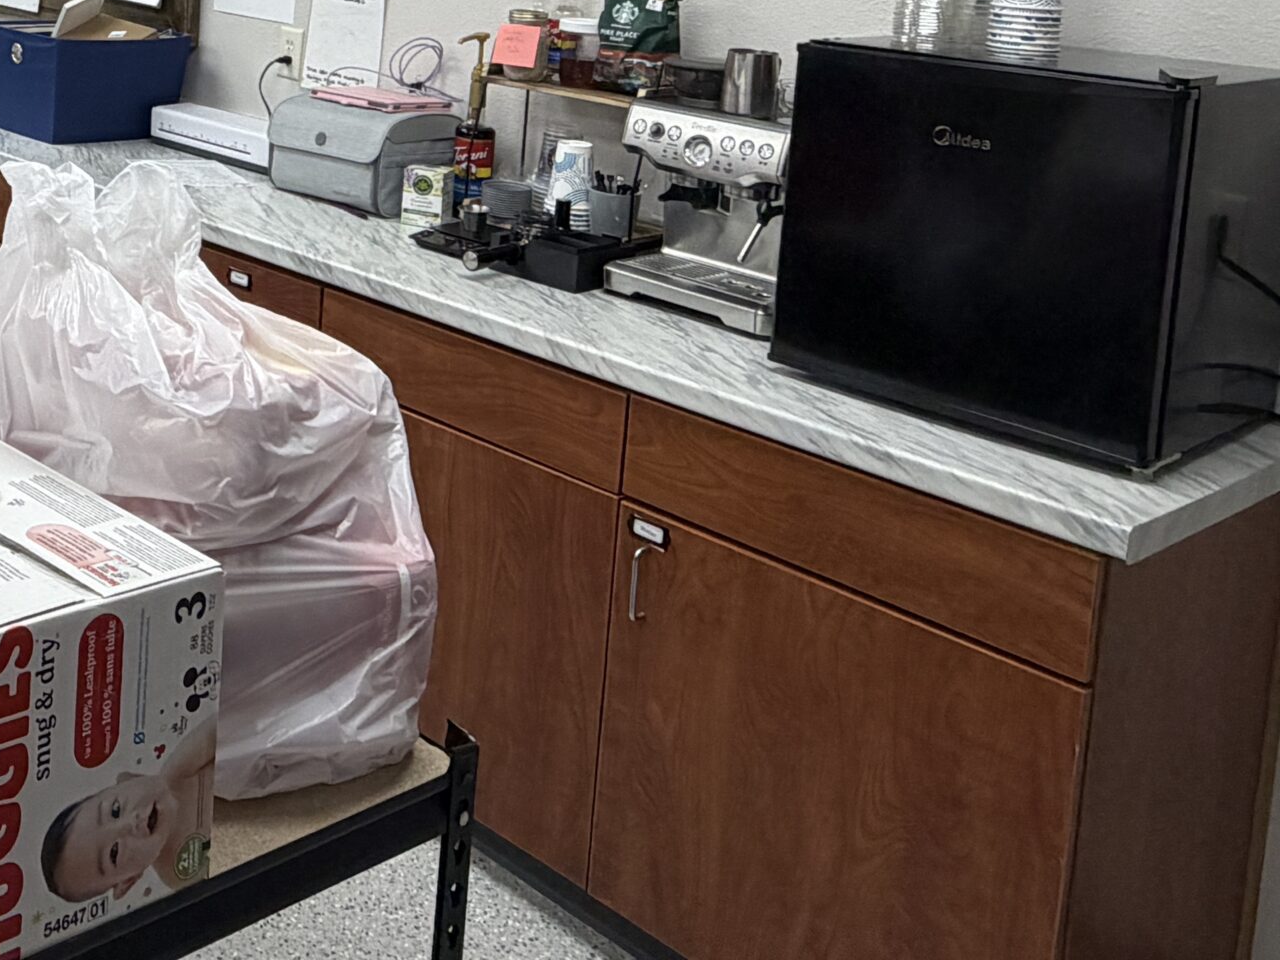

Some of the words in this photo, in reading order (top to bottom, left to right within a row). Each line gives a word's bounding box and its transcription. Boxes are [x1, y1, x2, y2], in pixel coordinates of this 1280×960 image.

[615, 31, 638, 39] PLACE
[932, 125, 991, 151] Midea
[175, 591, 207, 624] 3
[35, 639, 60, 684] dry
[84, 630, 97, 698] Leakproof
[106, 653, 115, 682] sans
[35, 690, 53, 710] &
[82, 701, 94, 738] 100%
[36, 715, 57, 782] snug
[43, 906, 87, 938] 54647
[90, 899, 107, 919] 01
